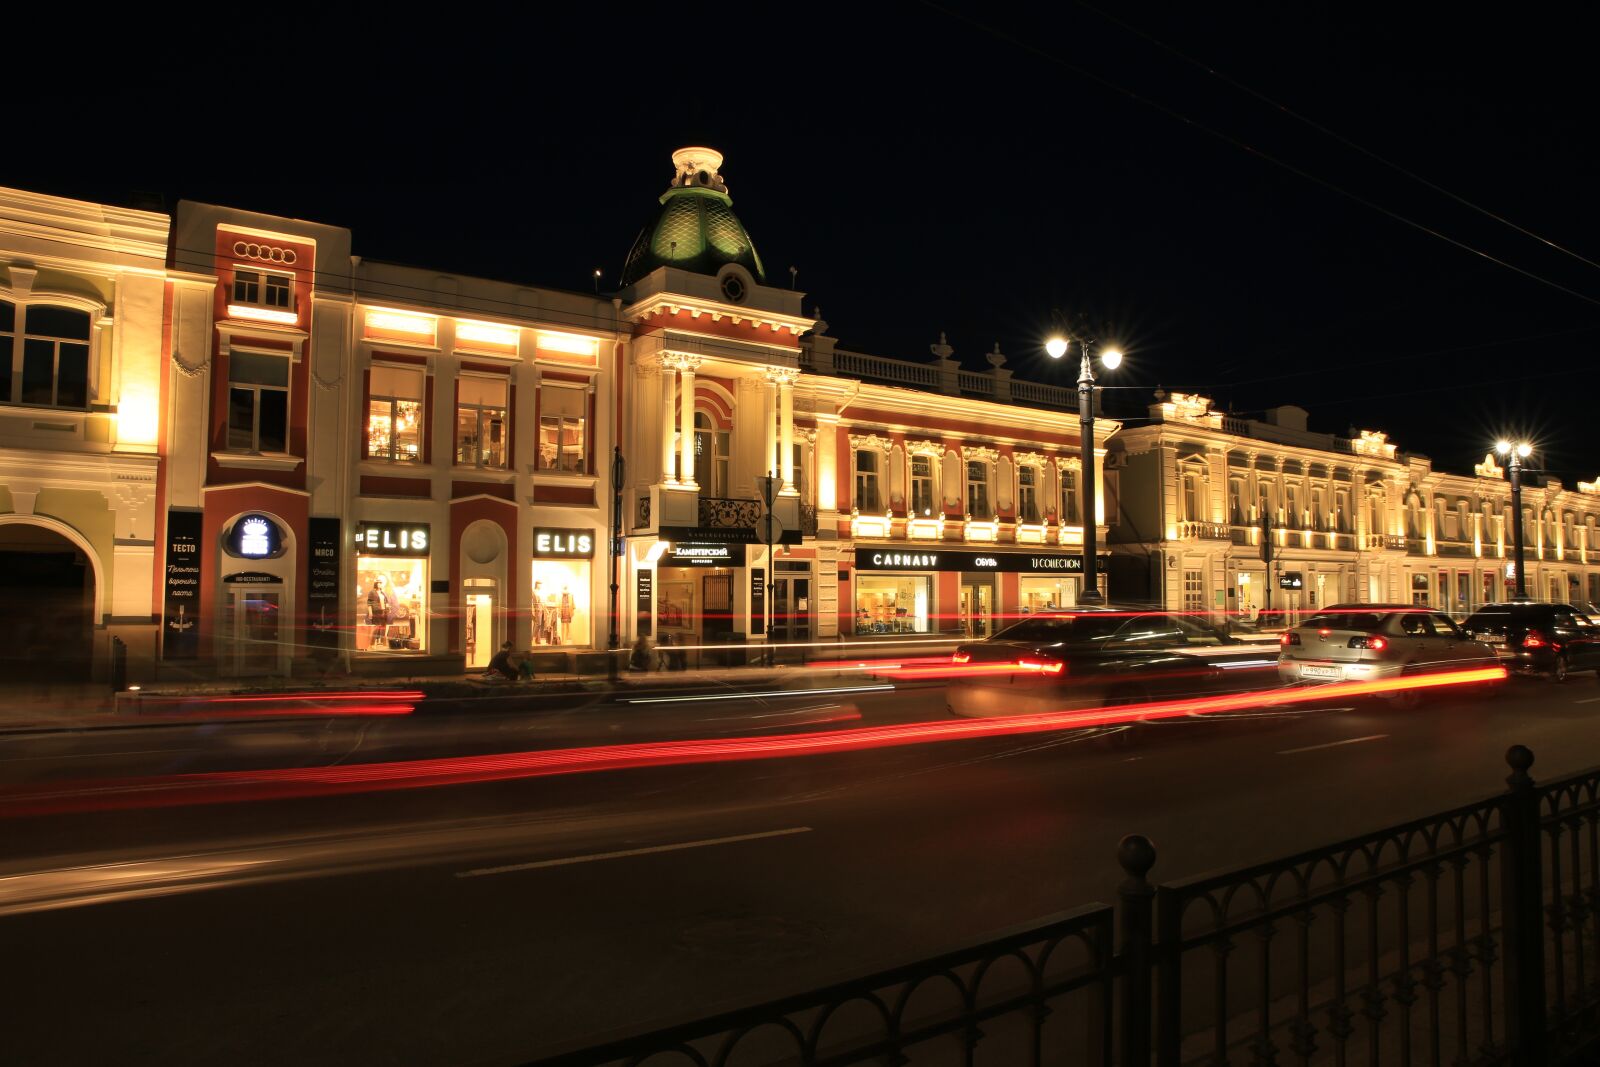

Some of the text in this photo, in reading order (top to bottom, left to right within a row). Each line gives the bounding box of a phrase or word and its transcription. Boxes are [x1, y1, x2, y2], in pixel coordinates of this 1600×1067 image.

[366, 529, 427, 550] ELIS
[537, 533, 591, 553] ELIS
[172, 543, 196, 553] ТЕСТО
[314, 548, 334, 558] МЯСО
[873, 554, 937, 566] CARNABY
[1039, 558, 1081, 569] COLLECTION
